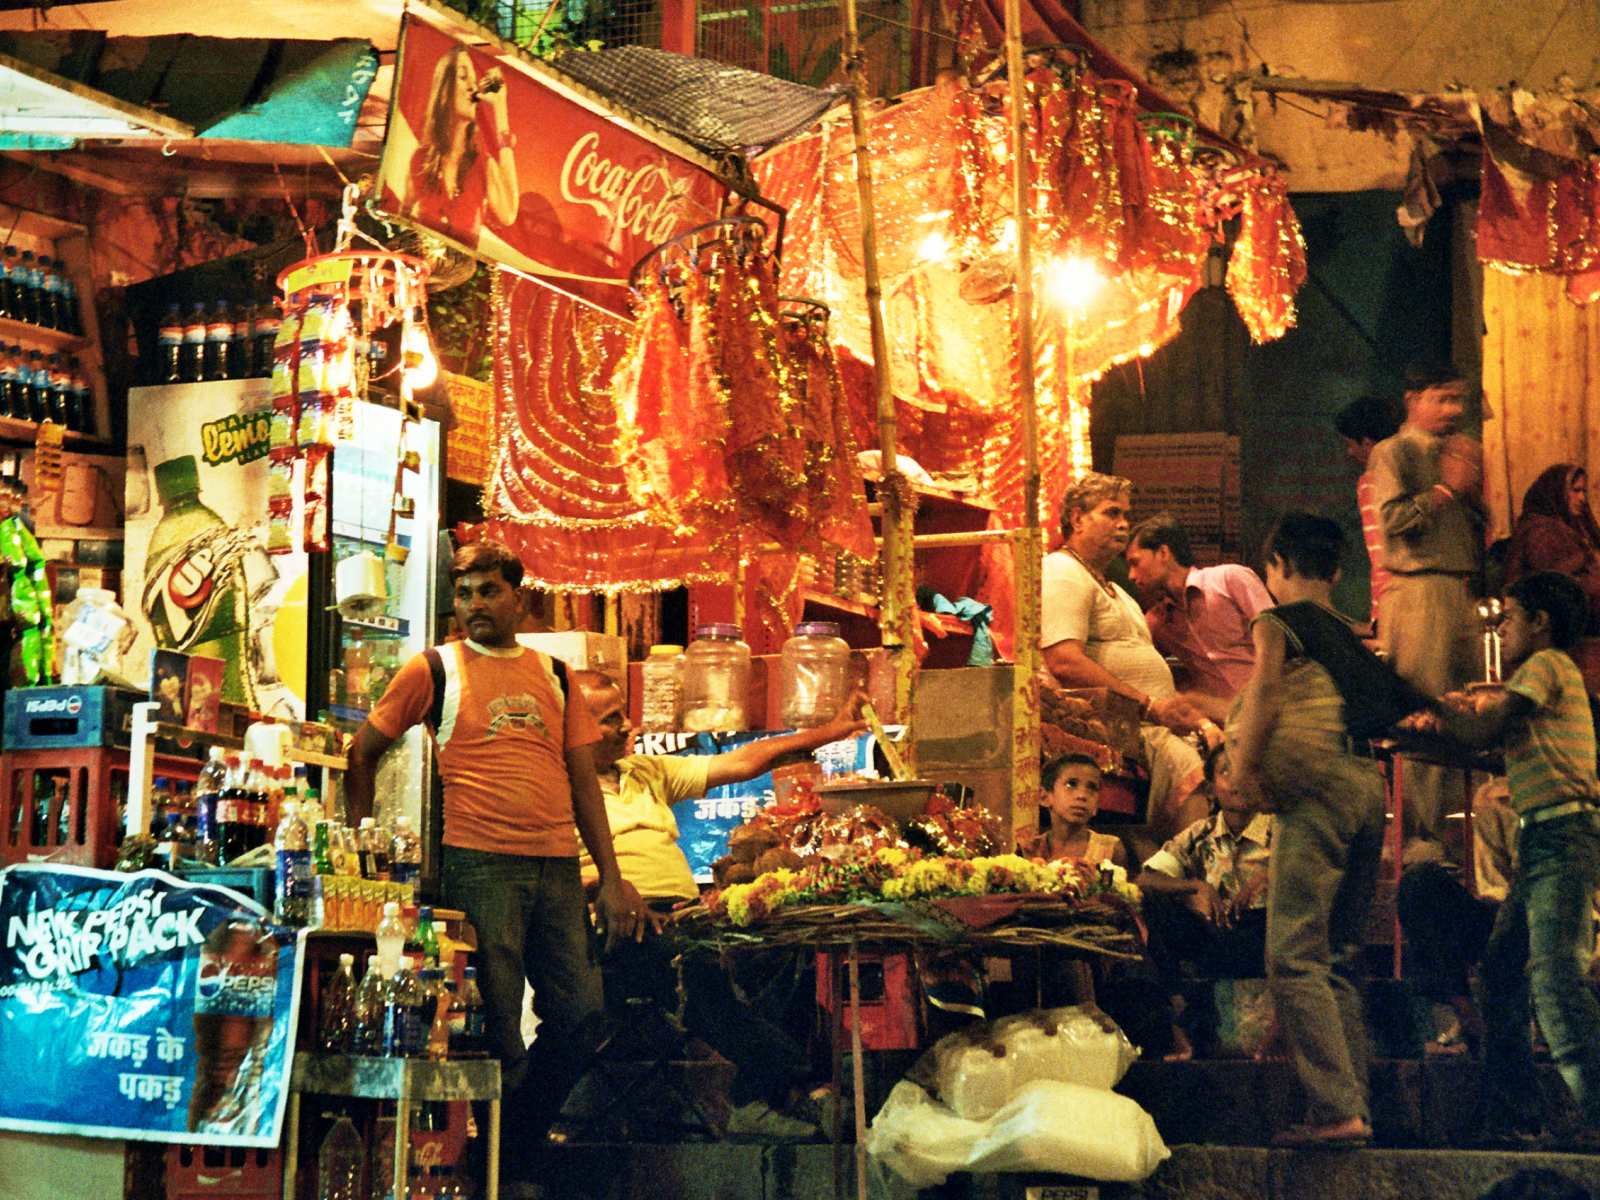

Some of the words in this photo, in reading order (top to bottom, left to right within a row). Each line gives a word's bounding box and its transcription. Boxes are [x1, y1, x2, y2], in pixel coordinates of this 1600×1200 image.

[7, 907, 80, 948] NEW
[25, 931, 103, 979] GRIP
[109, 907, 206, 966] PACK
[118, 1072, 186, 1110] पकड़
